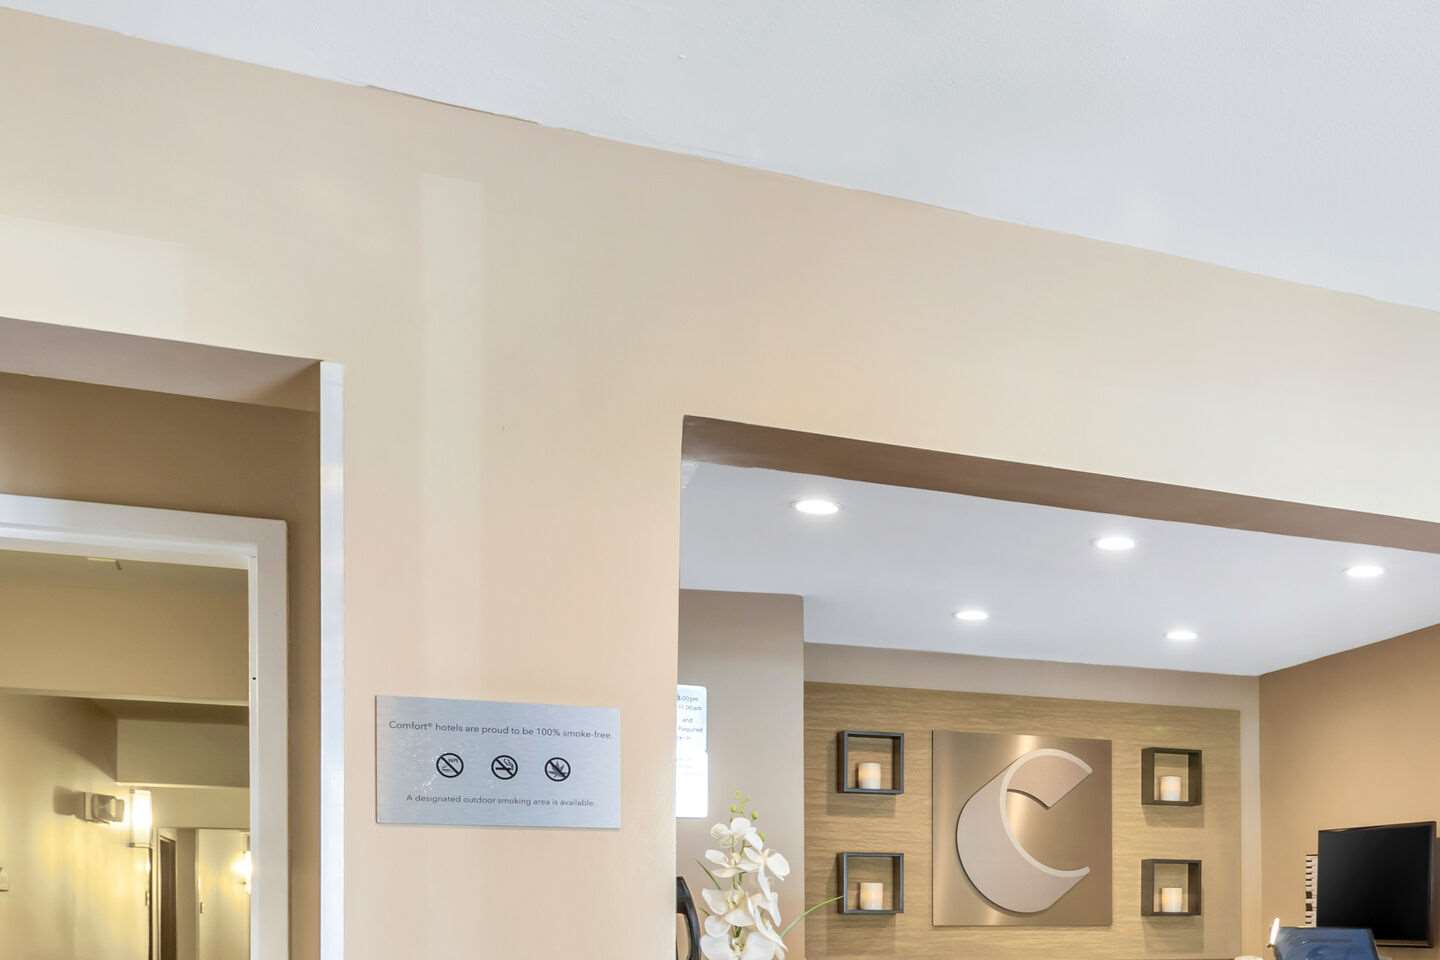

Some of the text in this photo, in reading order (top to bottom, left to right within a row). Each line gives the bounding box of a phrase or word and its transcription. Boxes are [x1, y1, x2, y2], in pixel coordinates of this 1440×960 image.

[435, 722, 463, 732] hotels
[481, 725, 510, 735] proud
[511, 727, 520, 735] to
[522, 727, 534, 735] be
[536, 727, 561, 737] 100%
[414, 794, 462, 804] designated
[462, 795, 496, 803] outdoor
[497, 797, 532, 806] smoking
